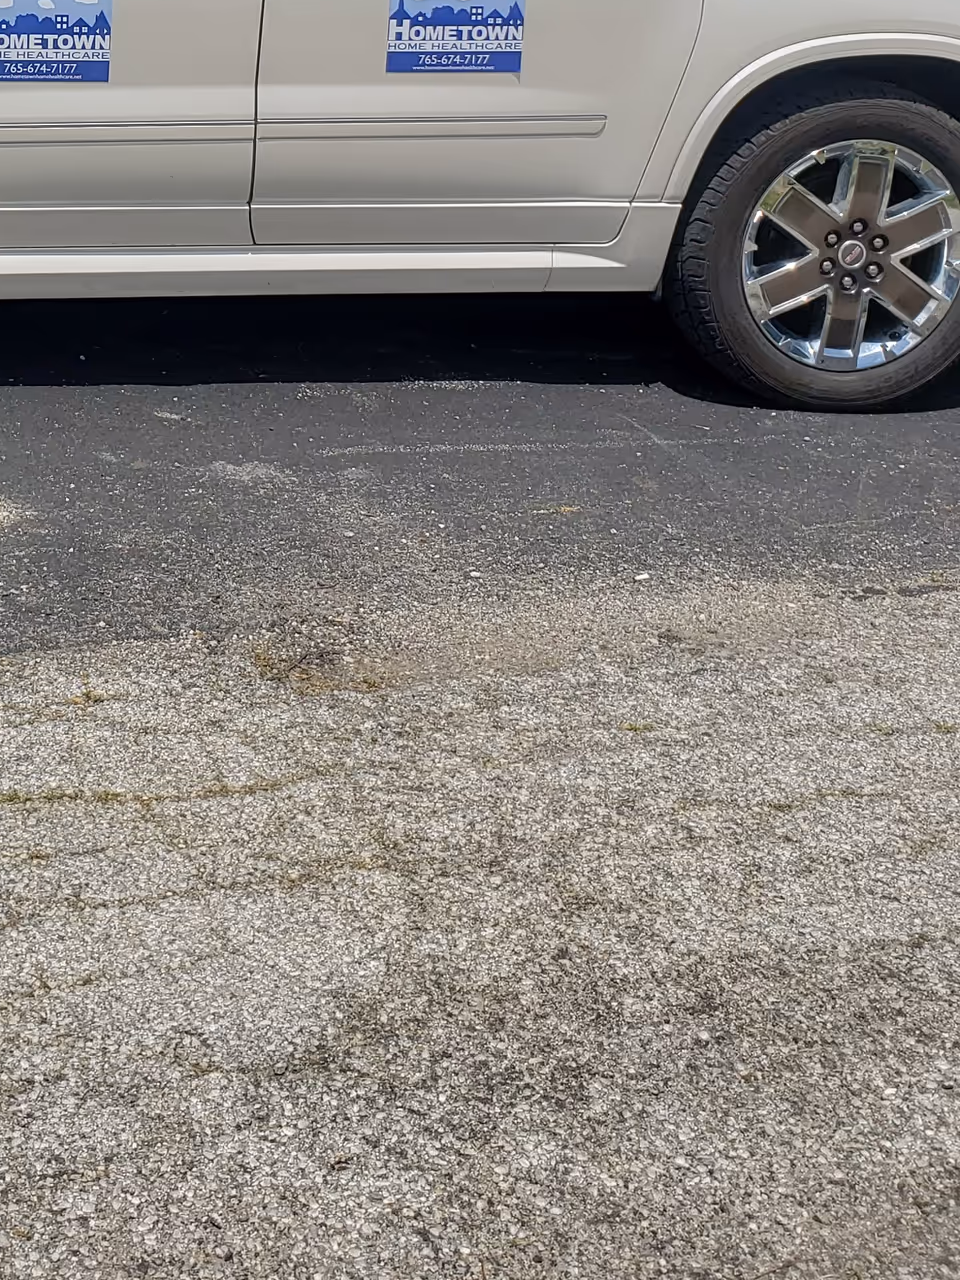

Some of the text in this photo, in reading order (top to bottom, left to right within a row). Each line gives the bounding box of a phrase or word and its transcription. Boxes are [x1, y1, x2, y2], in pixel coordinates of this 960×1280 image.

[388, 19, 523, 41] HOMETOWN
[388, 42, 523, 50] HOME HEALTHCARE
[16, 50, 110, 60] HEALTHCARE
[418, 54, 490, 65] 765-674-7177
[3, 63, 77, 74] 765-674-7177
